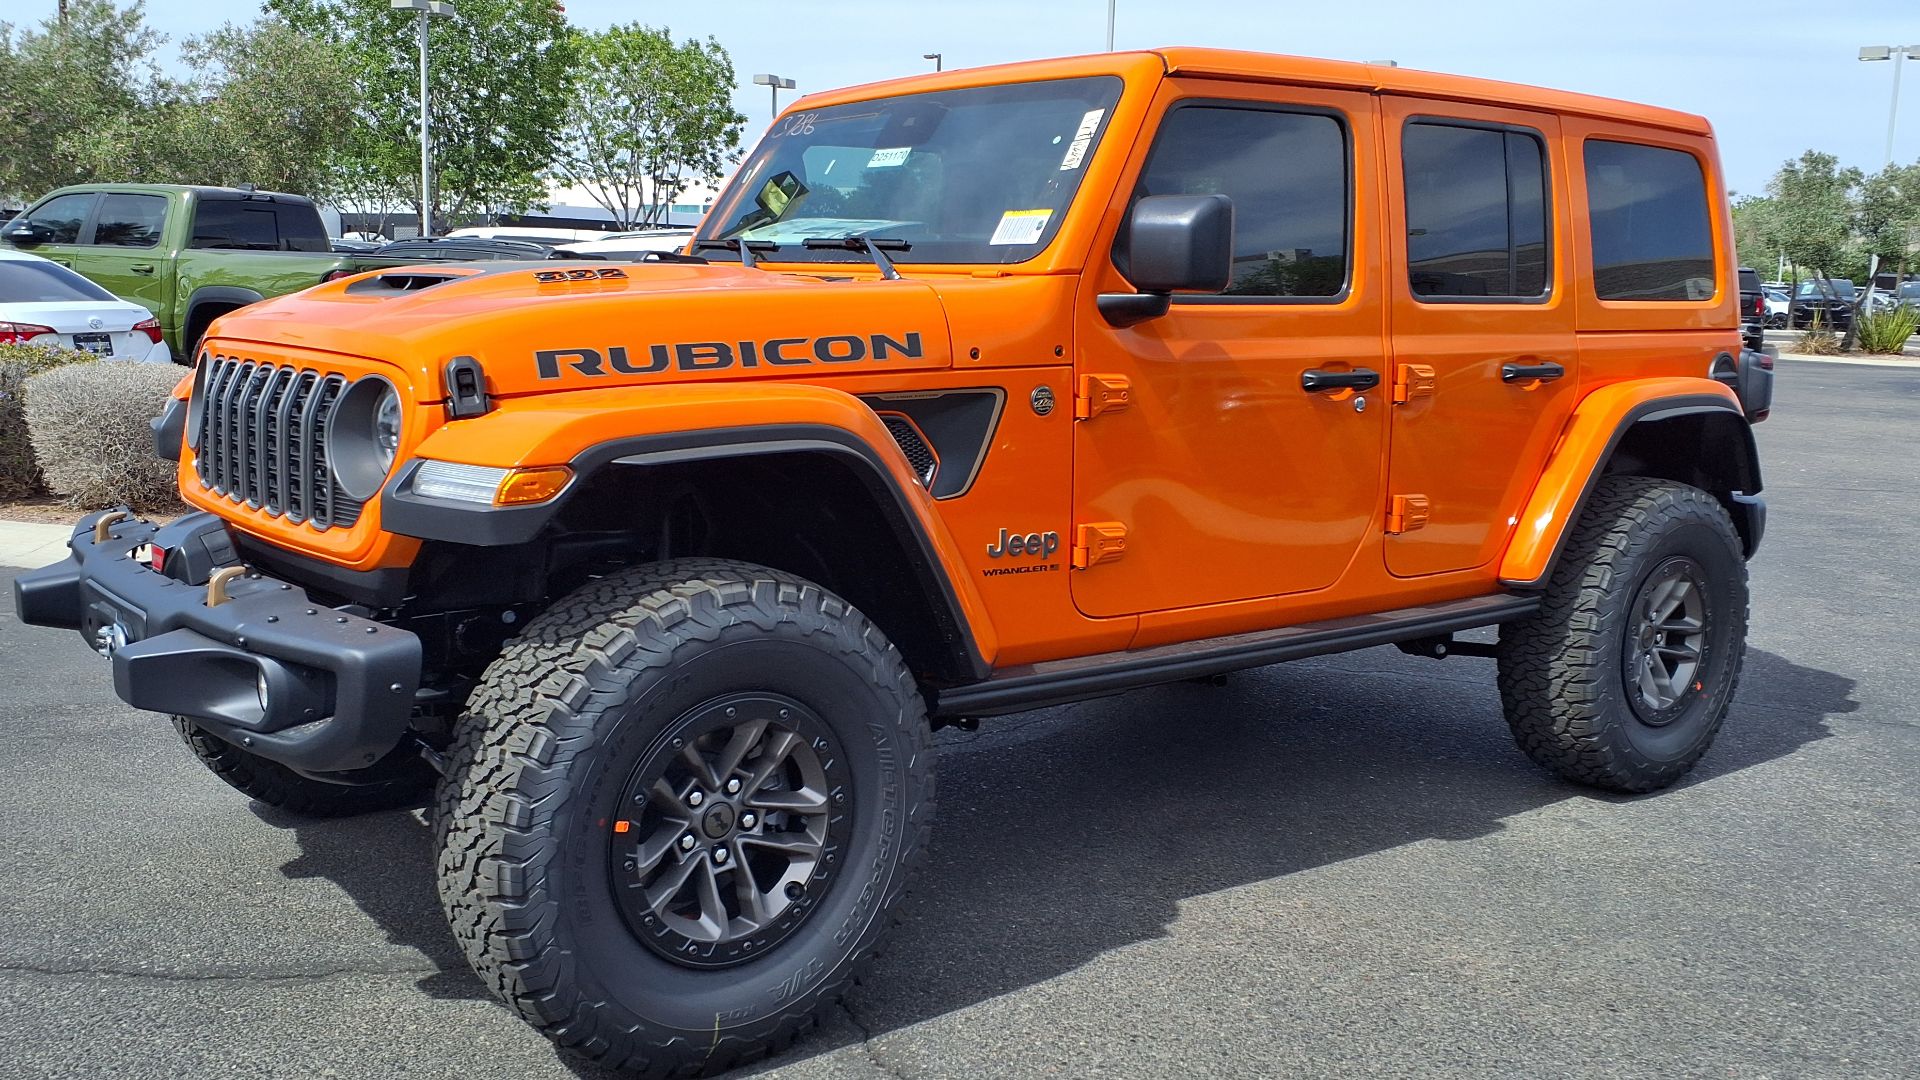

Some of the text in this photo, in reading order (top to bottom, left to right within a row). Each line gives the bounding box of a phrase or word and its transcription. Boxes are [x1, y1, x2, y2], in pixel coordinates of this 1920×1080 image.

[533, 332, 923, 380] RUBICON
[986, 527, 1059, 560] Jeep
[982, 564, 1048, 576] WRANGLER
